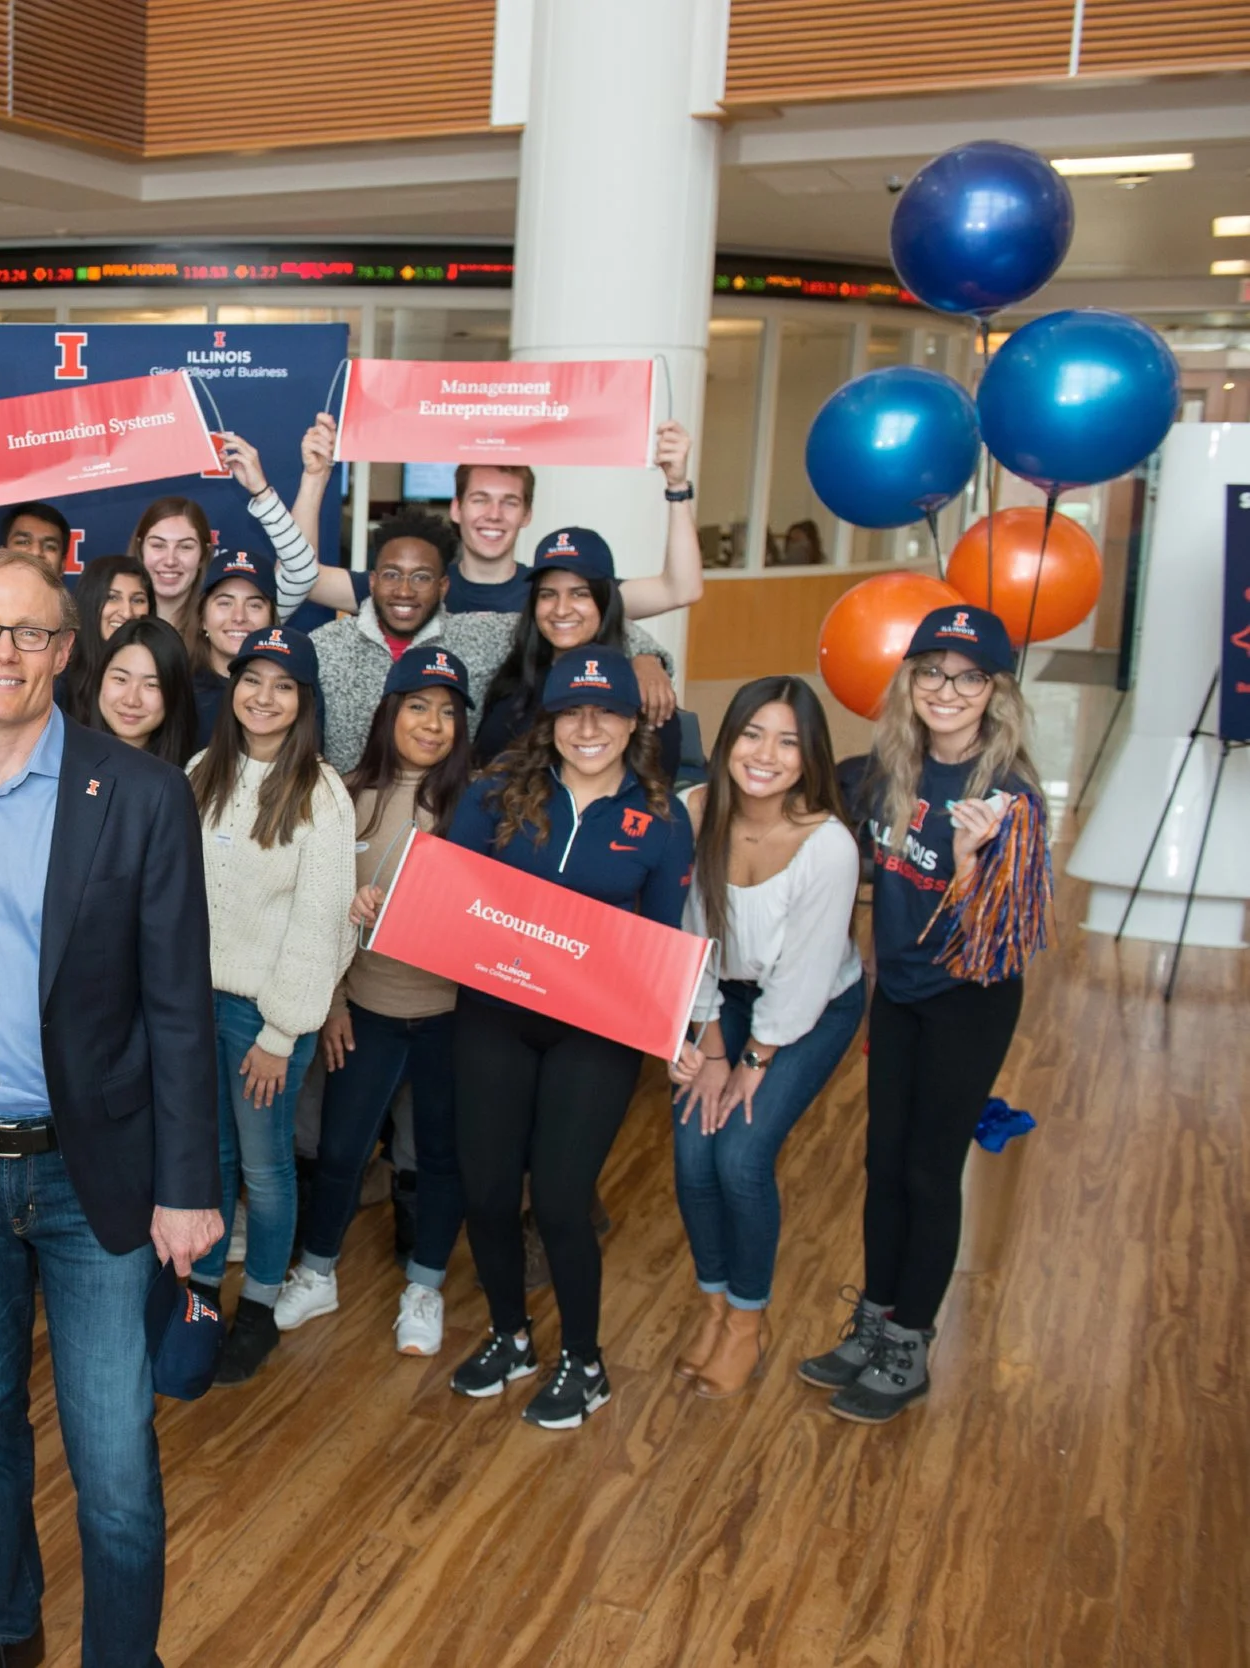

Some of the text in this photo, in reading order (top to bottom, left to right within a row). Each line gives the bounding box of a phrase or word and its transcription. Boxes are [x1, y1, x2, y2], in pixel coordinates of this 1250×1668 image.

[186, 350, 252, 364] ILLINOIS
[222, 366, 236, 378] of
[238, 366, 288, 378] Business
[440, 379, 552, 398] Management
[419, 400, 570, 421] Entrepreneurship
[6, 411, 176, 450] Information Systems
[466, 898, 591, 960] Accountancy
[496, 962, 532, 981] ILLINOIS
